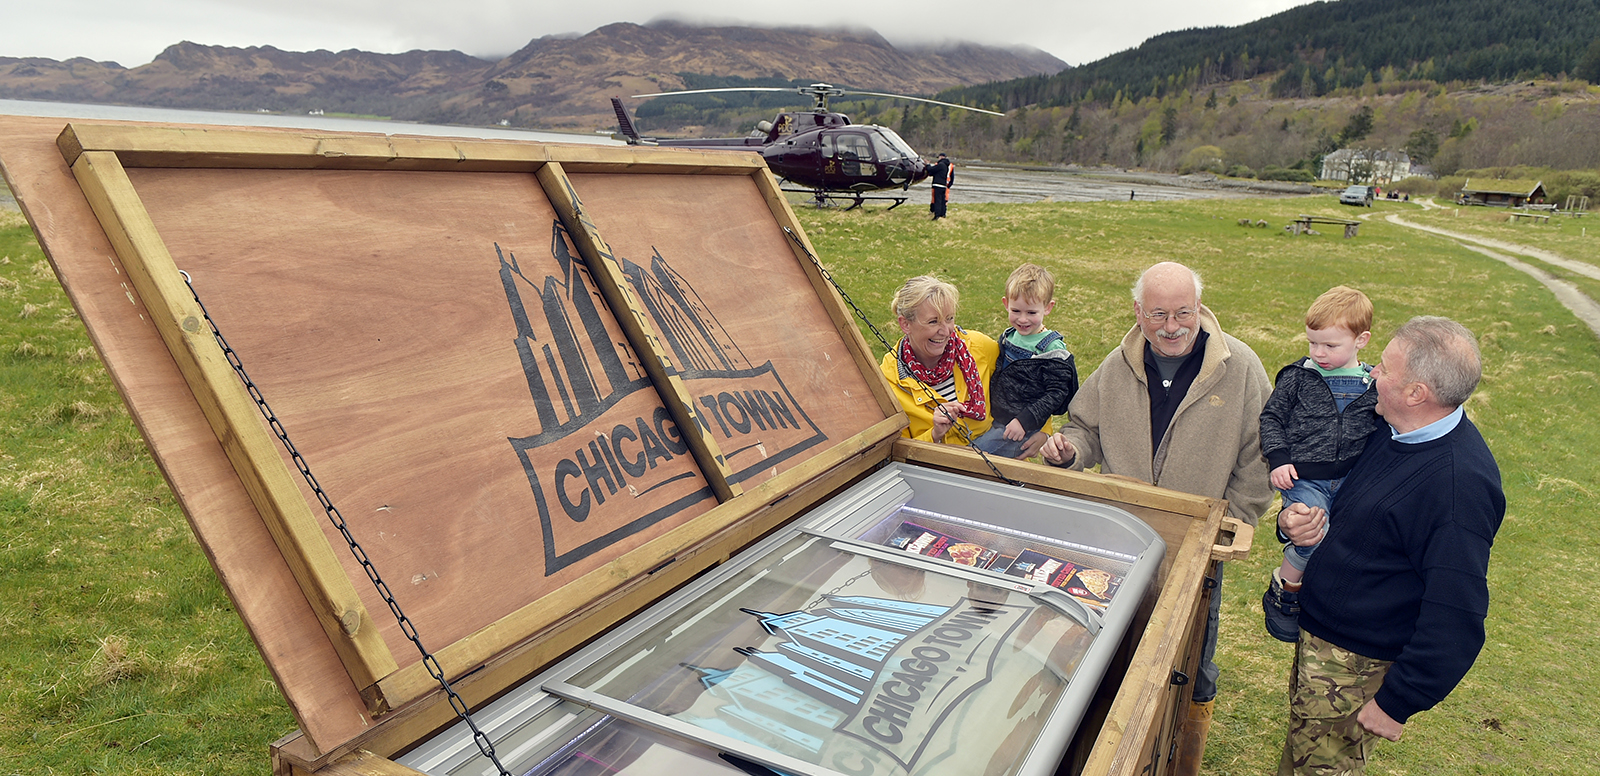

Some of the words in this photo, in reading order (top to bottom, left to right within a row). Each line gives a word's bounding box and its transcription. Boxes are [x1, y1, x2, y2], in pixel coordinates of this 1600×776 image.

[699, 389, 801, 439] TOWN
[862, 646, 951, 744] CHICAGO
[922, 606, 1009, 648] TOWN
